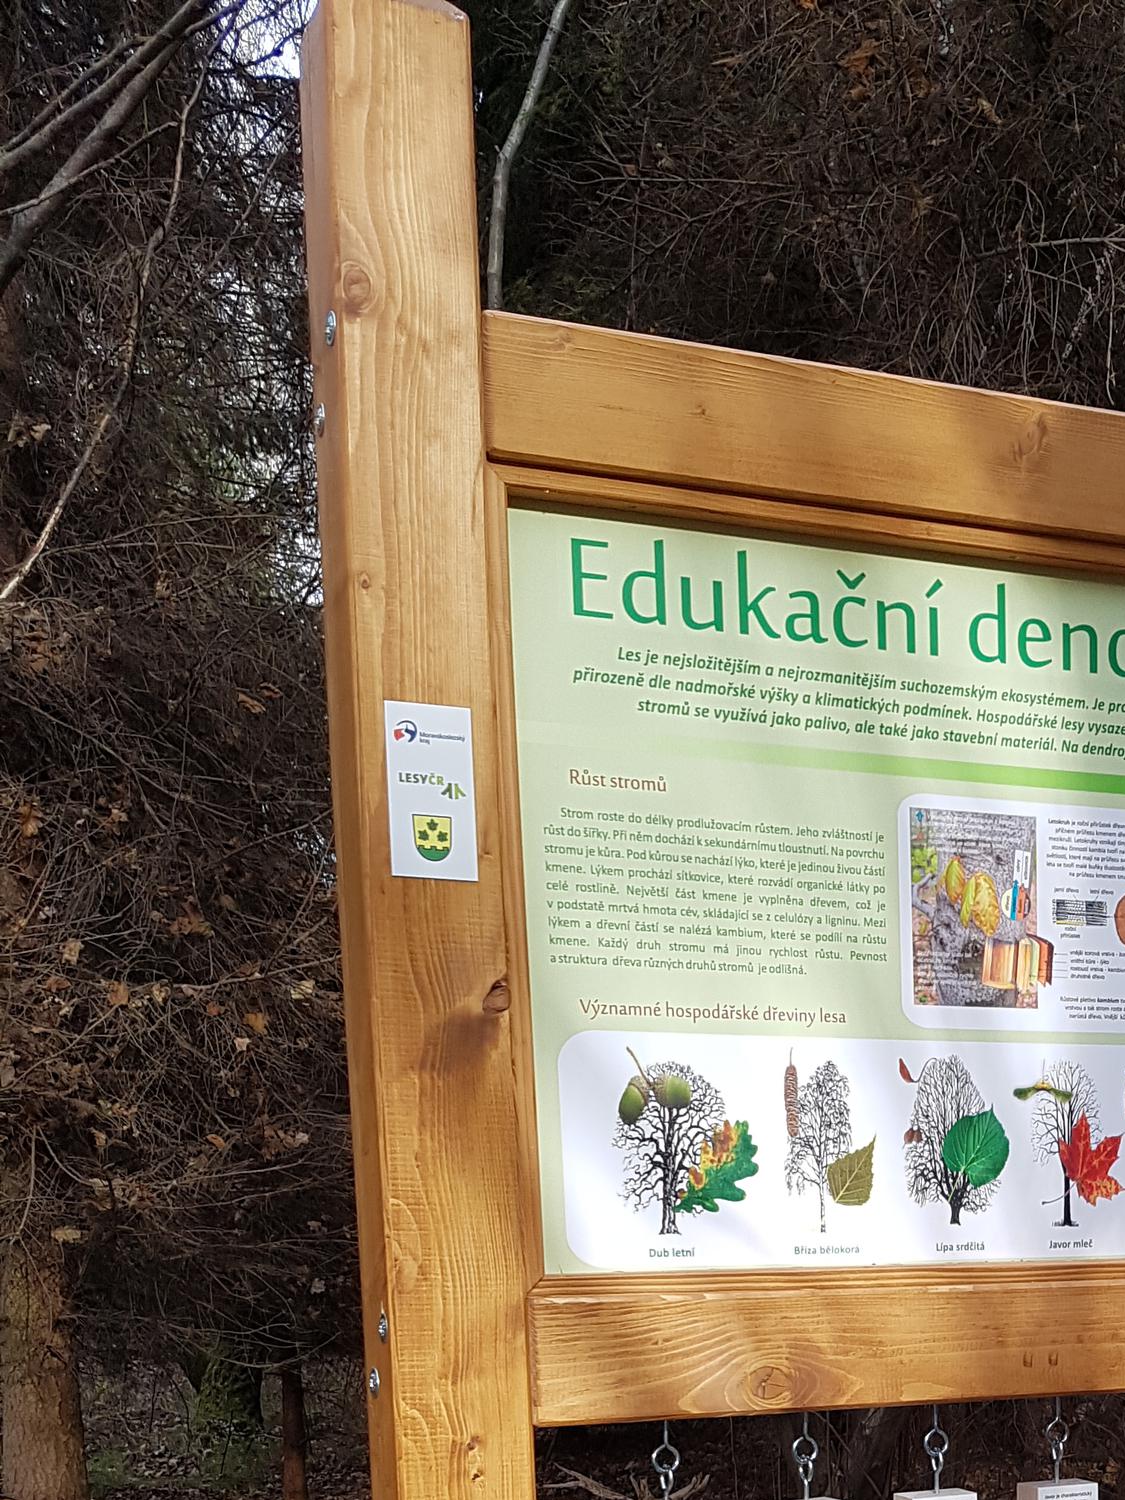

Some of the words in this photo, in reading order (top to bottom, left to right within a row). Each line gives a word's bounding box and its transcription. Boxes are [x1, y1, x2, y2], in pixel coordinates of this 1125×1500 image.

[570, 537, 943, 656] Edukační
[617, 646, 641, 662] Les
[643, 648, 658, 666] je
[662, 652, 760, 675] nejsložitějším
[764, 666, 774, 676] a
[777, 665, 896, 690] nejrozmanitějším
[899, 678, 997, 701] suchozemským
[1001, 688, 1088, 709] ekosystémem.
[1091, 697, 1105, 711] Je
[572, 666, 644, 687] přirozeně
[648, 674, 671, 689] dle
[675, 678, 755, 698] nadmořské
[759, 686, 798, 706] výšky
[802, 694, 811, 704] a
[814, 690, 899, 714] klimatických
[902, 702, 971, 720] podmínek.
[976, 708, 1057, 728] Hospodářské
[1060, 715, 1084, 734] lesy
[637, 699, 690, 715] stromů
[693, 706, 709, 717] se
[713, 706, 767, 723] využívá
[769, 710, 801, 727] jako
[804, 715, 850, 734] palivo,
[854, 719, 875, 734] ale
[878, 722, 908, 737] také
[909, 724, 939, 741] jako
[942, 729, 998, 745] stavební
[1000, 736, 1056, 751] materiál.
[1061, 739, 1078, 753] Na
[569, 768, 606, 787] Růst
[609, 775, 666, 792] stromů
[560, 806, 593, 819] Strom
[597, 812, 624, 822] roste
[627, 812, 642, 823] do
[644, 813, 673, 828] délky
[676, 817, 751, 832] prodlužovacím
[754, 822, 793, 835] růstem.
[795, 825, 819, 837] Jeho
[875, 831, 884, 844] je
[579, 998, 661, 1020] Významné
[665, 1000, 758, 1023] hospodářské
[762, 1005, 815, 1028] dřeviny
[819, 1007, 846, 1023] lesa
[648, 1247, 669, 1257] Dub
[671, 1247, 694, 1257] letní
[955, 1241, 984, 1251] srdčitá
[1048, 1240, 1071, 1248] Javor
